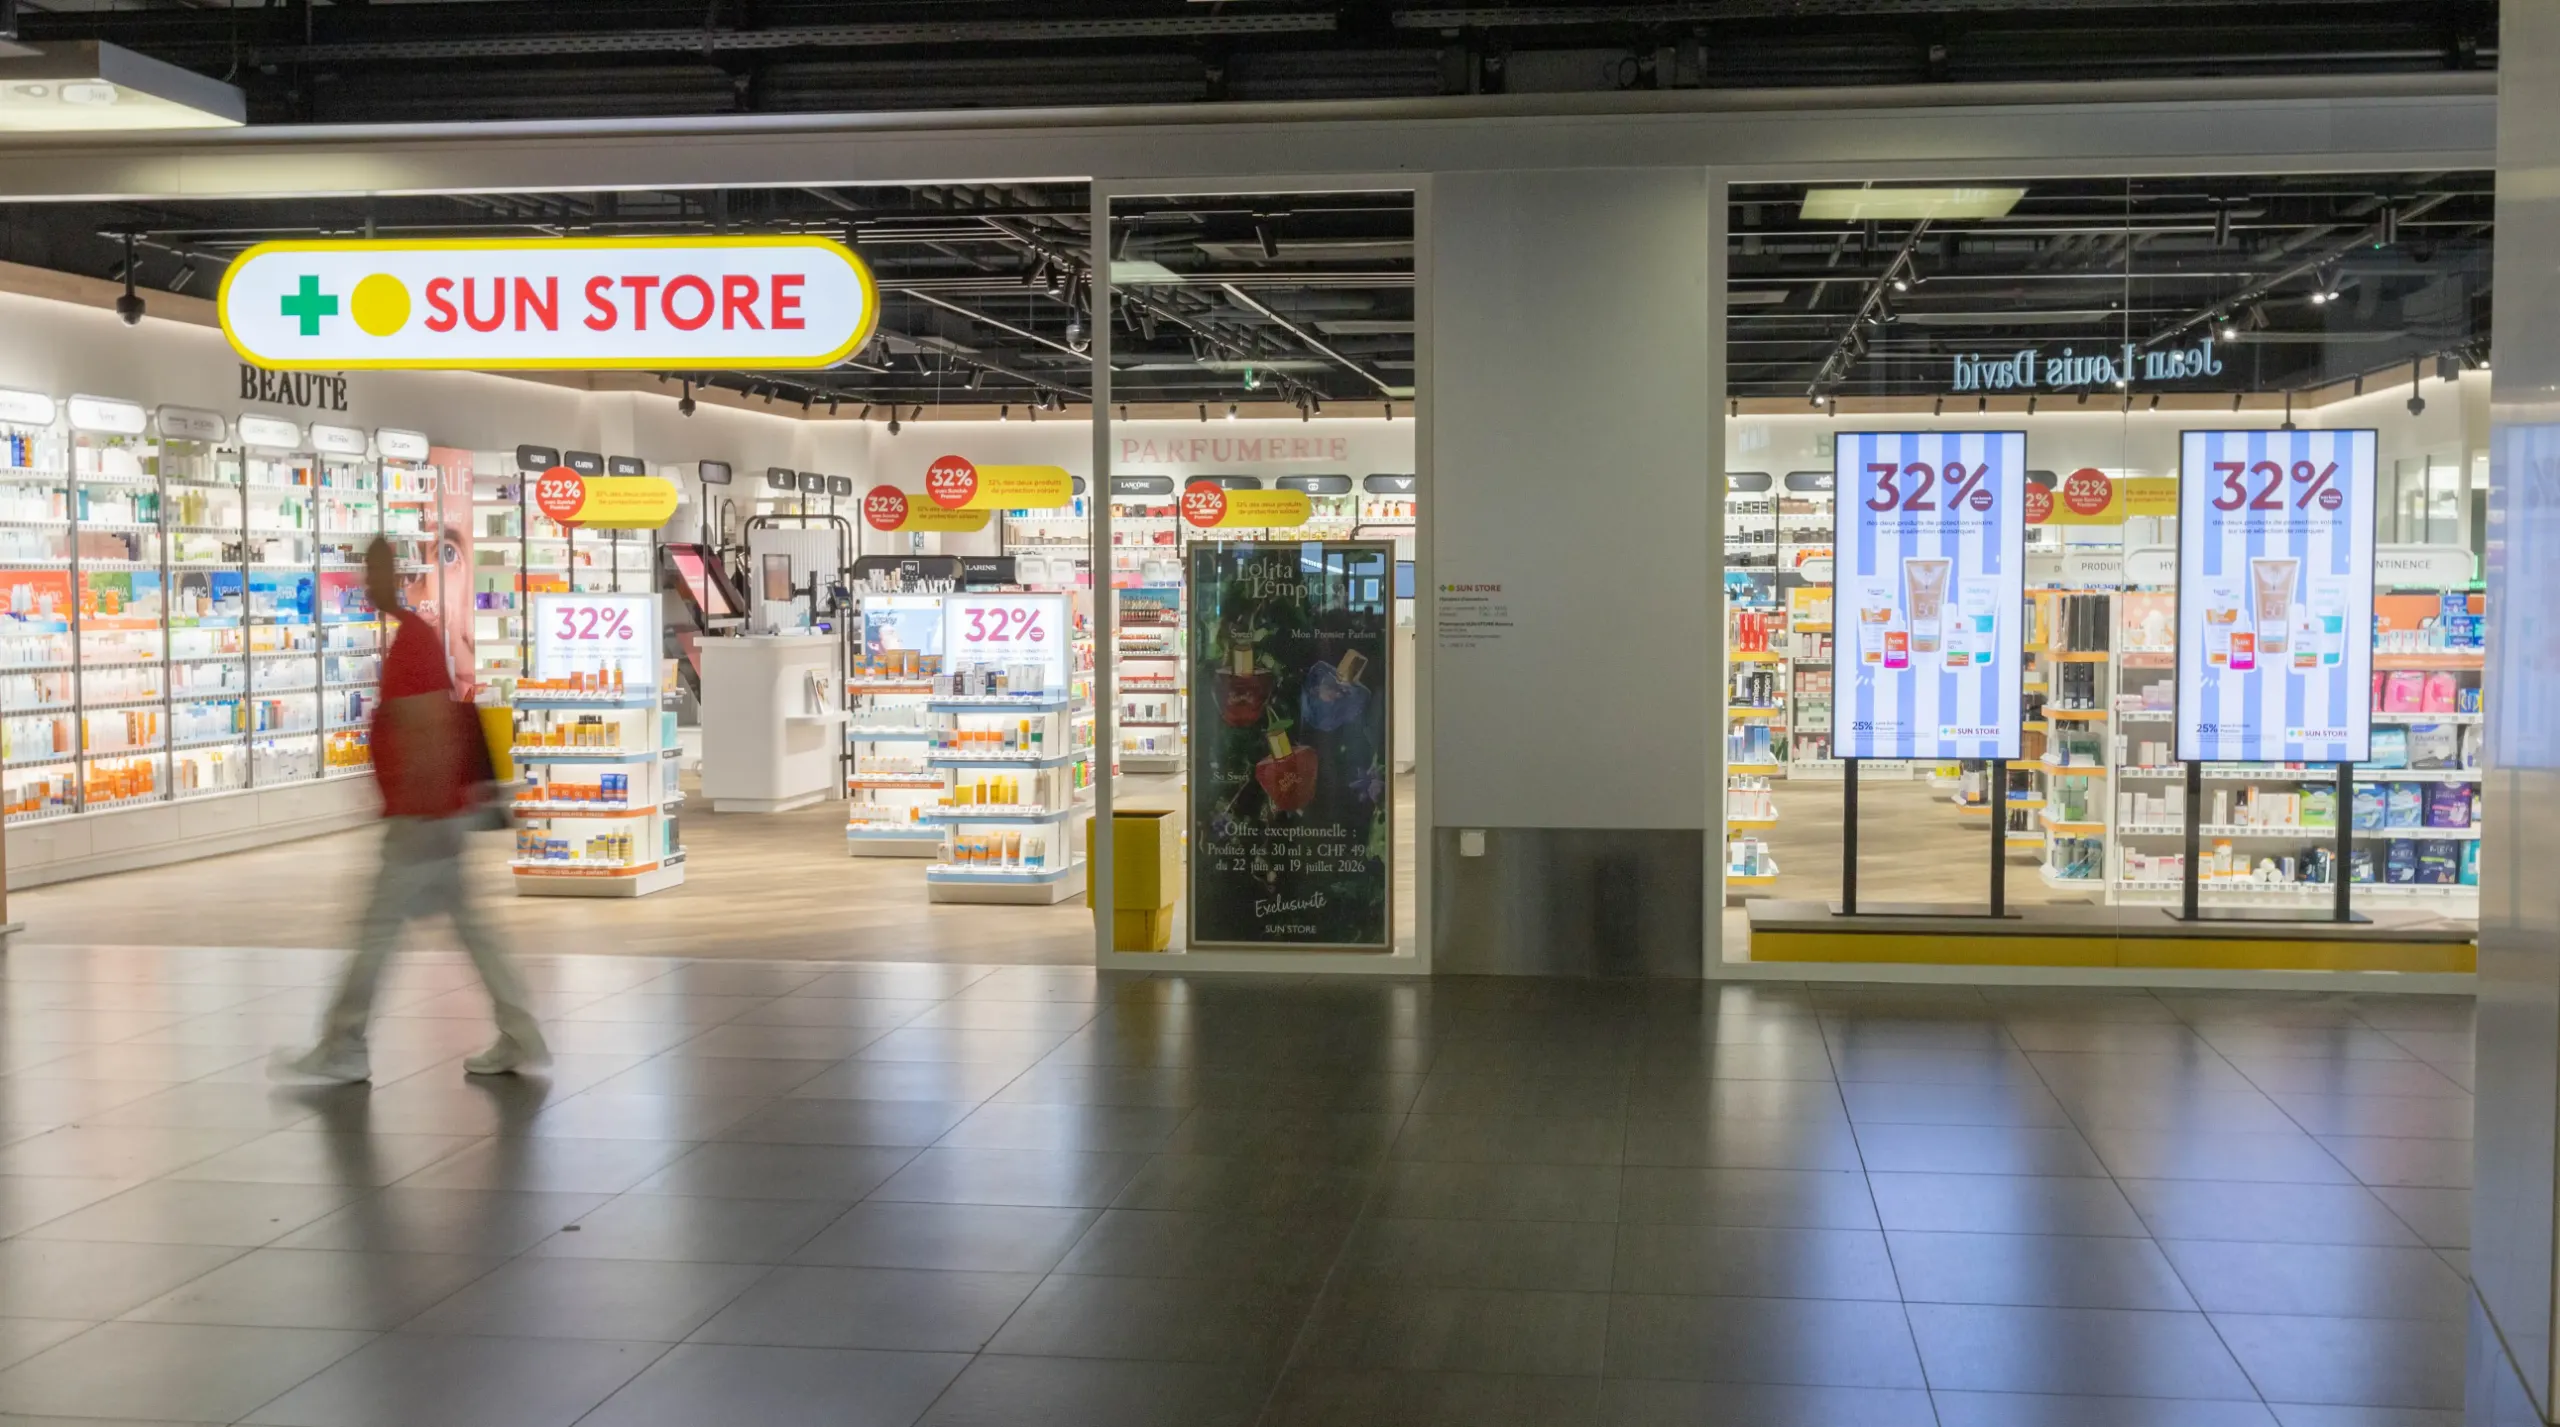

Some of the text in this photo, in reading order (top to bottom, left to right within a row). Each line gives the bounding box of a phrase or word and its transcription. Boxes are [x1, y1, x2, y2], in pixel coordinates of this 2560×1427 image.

[424, 273, 805, 333] SUN STORE
[239, 363, 349, 411] BEAUTÉ
[1120, 437, 1348, 464] PARFUMERIE
[931, 468, 973, 487] 32%
[1865, 462, 1993, 512] 32%
[2212, 460, 2343, 511] 32%
[540, 480, 581, 499] 32%
[2069, 481, 2108, 497] 32%
[868, 496, 904, 513] 32%
[1186, 493, 1222, 509] 32%
[2025, 494, 2050, 507] 2%
[1236, 557, 1294, 581] Lolita
[2376, 560, 2432, 569] NTINENCE
[1456, 584, 1502, 592] SUN STORE
[555, 607, 633, 640] 32%
[964, 608, 1045, 642] 32%
[1291, 629, 1376, 639] Mon Premier Parfum
[1852, 721, 1874, 731] 25%
[2196, 723, 2218, 733] 25%
[1225, 821, 1260, 837] Offre
[1264, 823, 1347, 841] exceptionnelle
[1208, 843, 1246, 856] Profitez
[1249, 843, 1267, 856] des
[1271, 843, 1286, 856] 30
[1287, 843, 1301, 856] ml
[1317, 843, 1347, 856] CHF
[1351, 843, 1366, 856] 49
[1215, 859, 1365, 875] du 22 juin au 19 juillet 2026
[1255, 891, 1328, 918] Exclusivité
